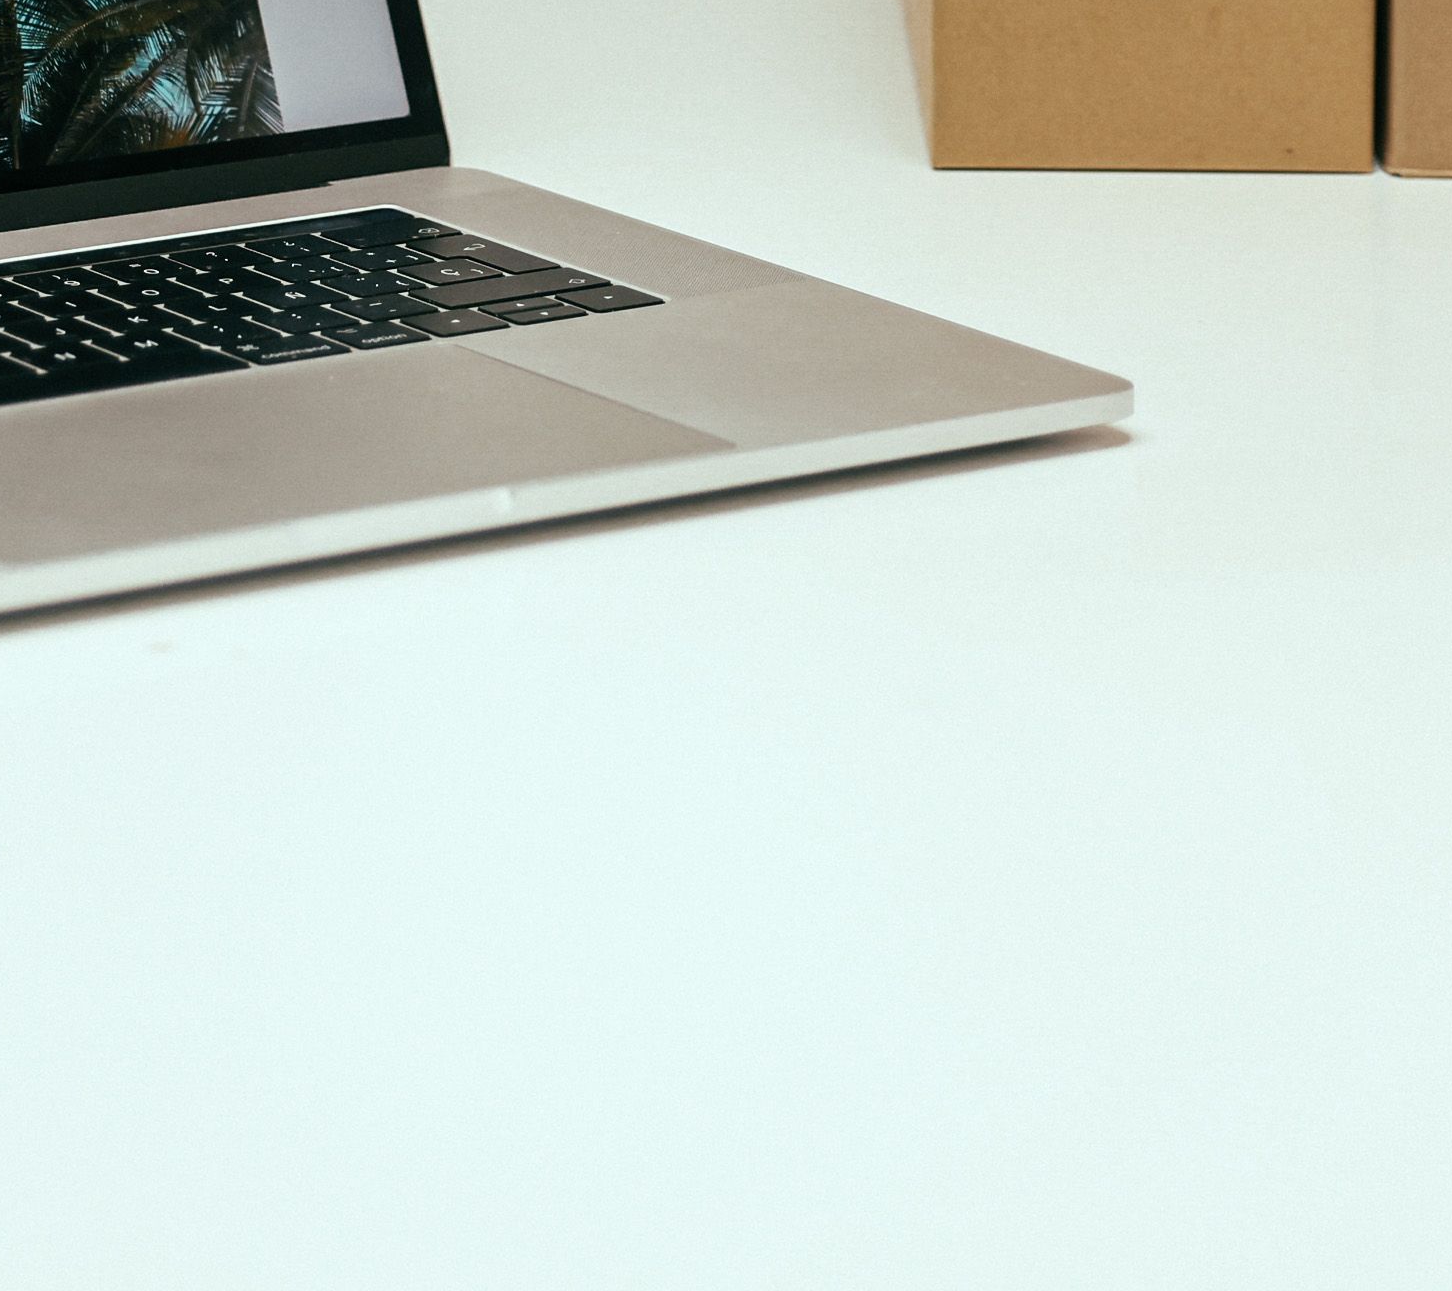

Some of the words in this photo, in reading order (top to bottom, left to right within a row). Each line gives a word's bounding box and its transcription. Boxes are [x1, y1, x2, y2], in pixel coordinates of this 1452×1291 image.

[133, 339, 159, 349] M
[361, 332, 408, 344] option
[261, 344, 331, 359] command
